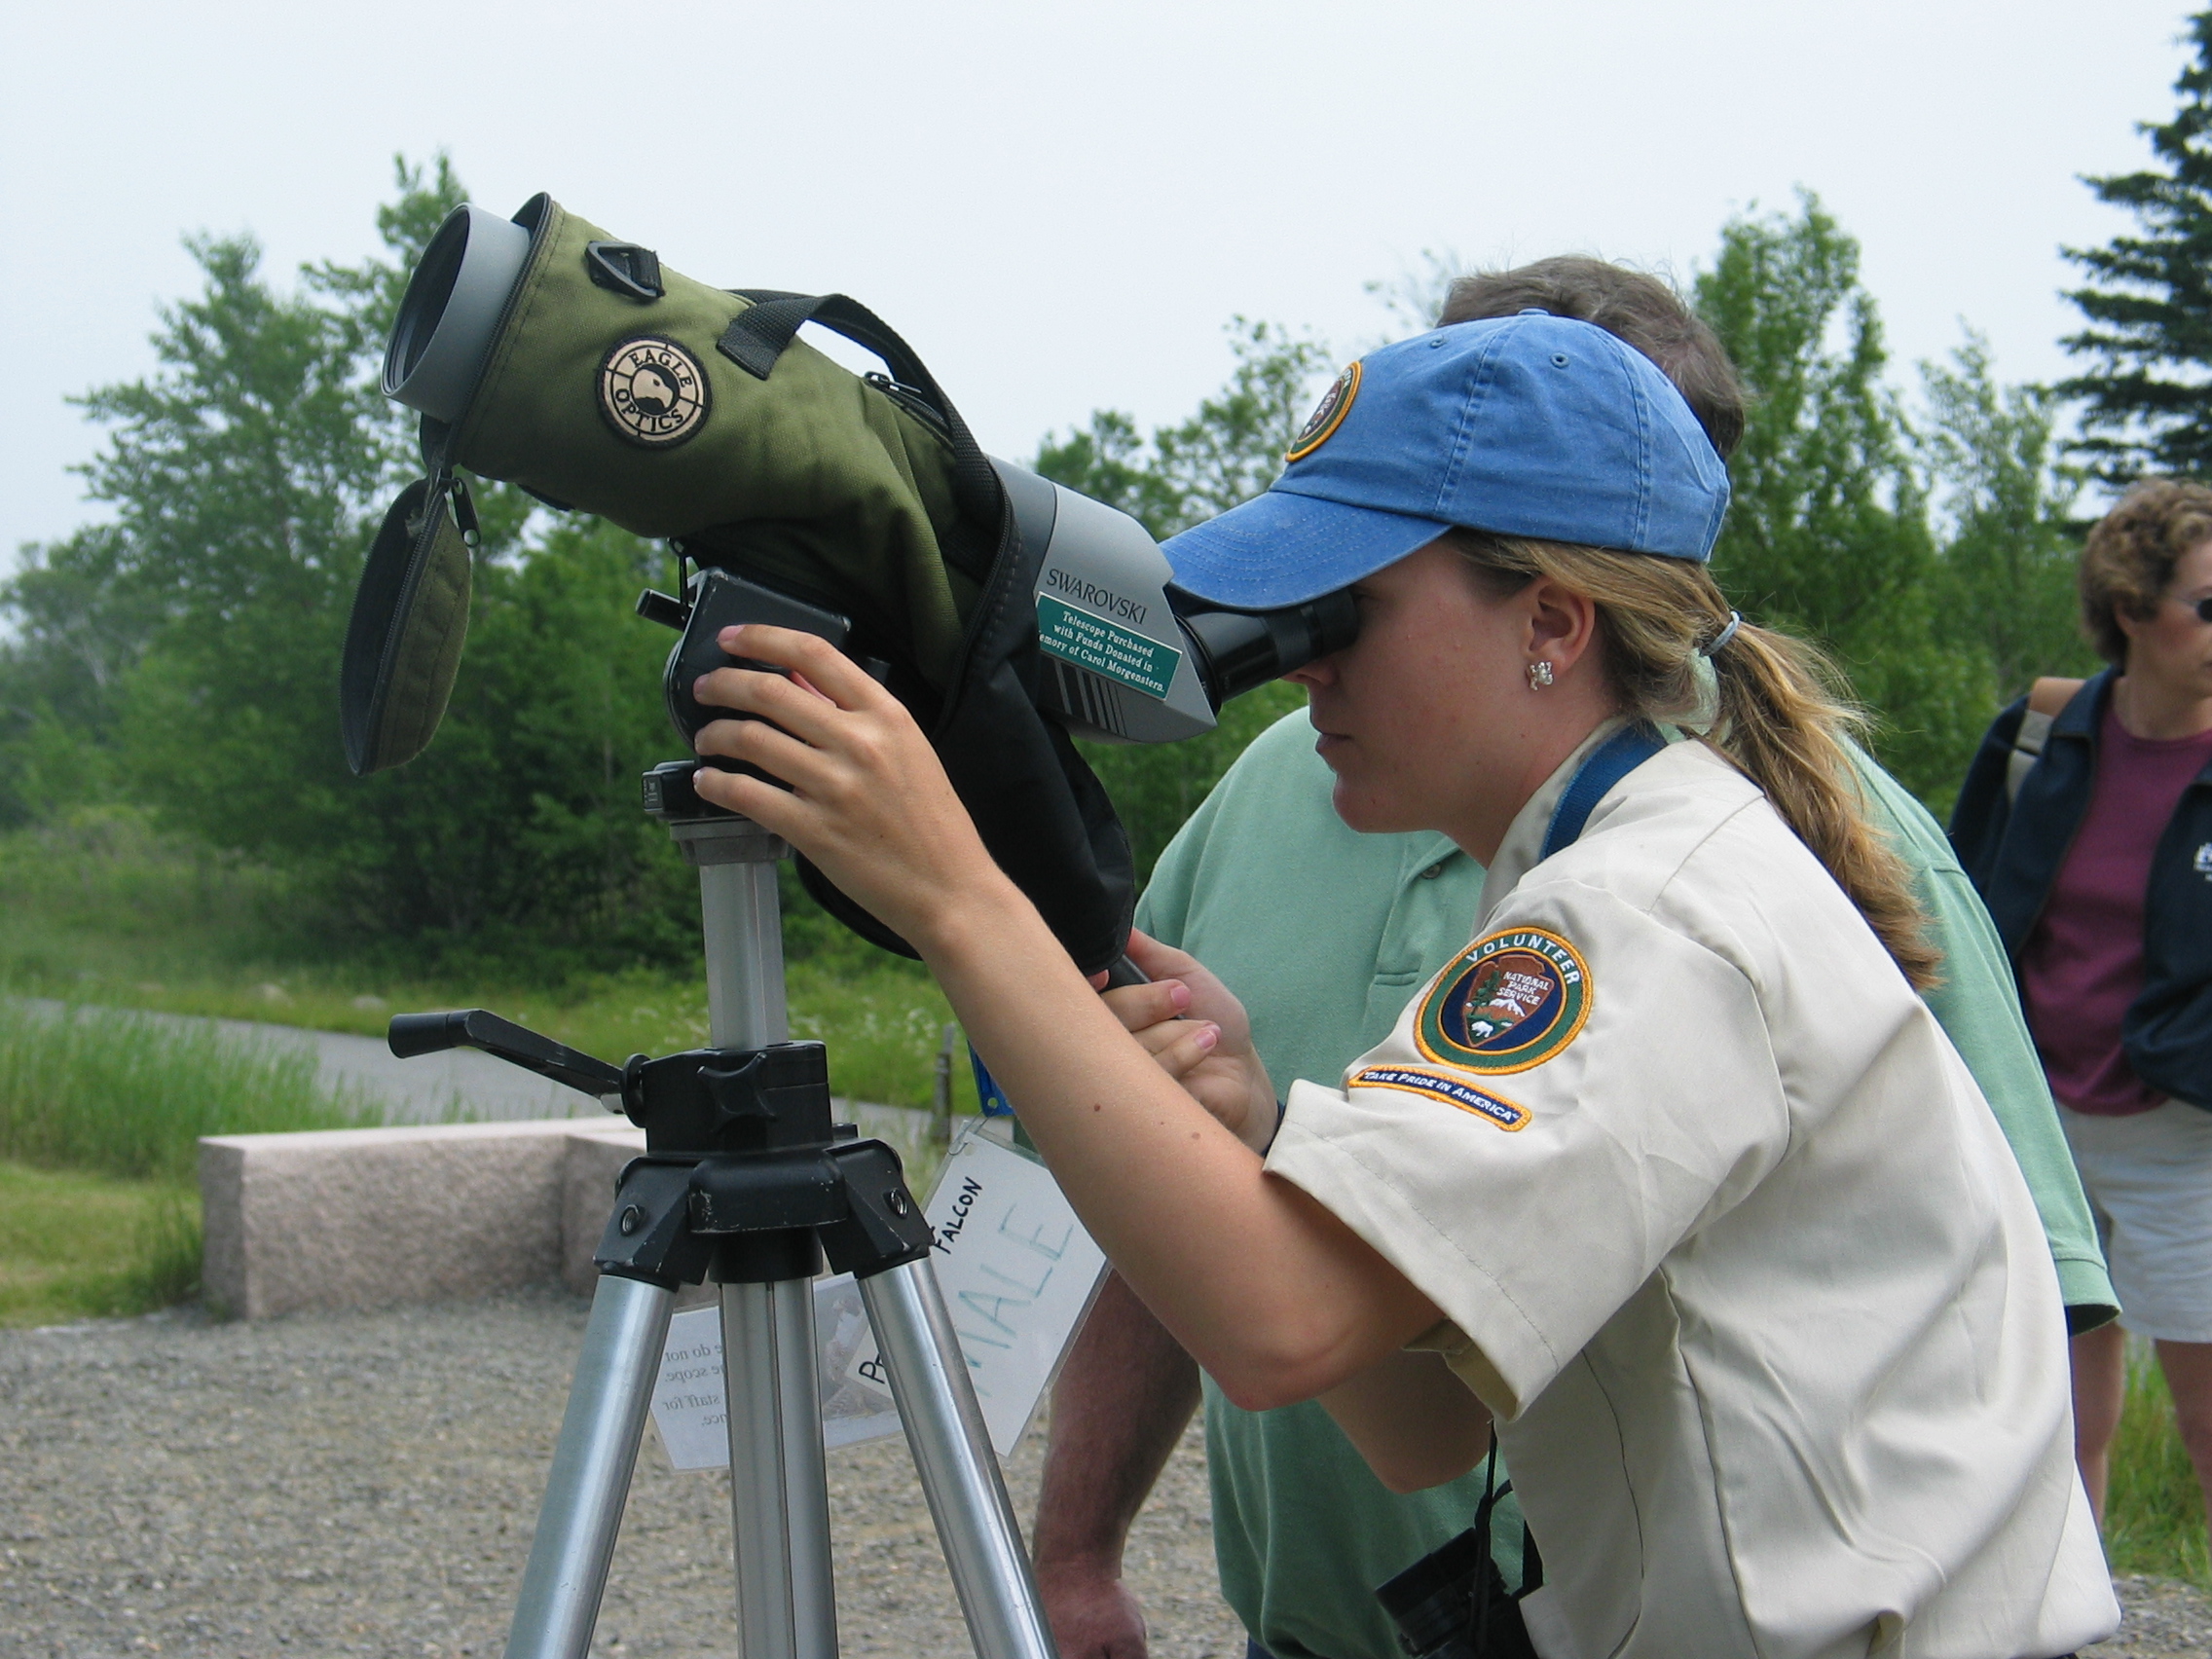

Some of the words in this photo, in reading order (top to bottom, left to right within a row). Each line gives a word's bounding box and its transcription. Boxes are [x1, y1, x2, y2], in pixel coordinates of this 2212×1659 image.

[628, 349, 692, 387] EAGLE
[615, 388, 683, 431] OPTICS
[1047, 569, 1148, 625] SWAROVSKI
[1053, 624, 1074, 640] with
[1076, 631, 1104, 651] Funds
[1105, 643, 1145, 668] Donated
[1143, 660, 1153, 672] in
[1063, 610, 1105, 638] Telescope
[1108, 630, 1155, 657] Purchased
[1038, 633, 1068, 651] emory
[1069, 645, 1079, 656] of
[1081, 649, 1105, 667] Carol
[1107, 659, 1164, 692] Morgenstern.
[1465, 934, 1580, 984] VOLUNTEER
[1503, 971, 1549, 991] NATIONAL
[1496, 986, 1541, 1006] SERVICE
[1507, 981, 1537, 995] PARK
[1364, 1071, 1397, 1082] TAKE
[1397, 1073, 1436, 1088] PRIDE
[1436, 1081, 1452, 1092] IN
[930, 1176, 983, 1255] FALCON
